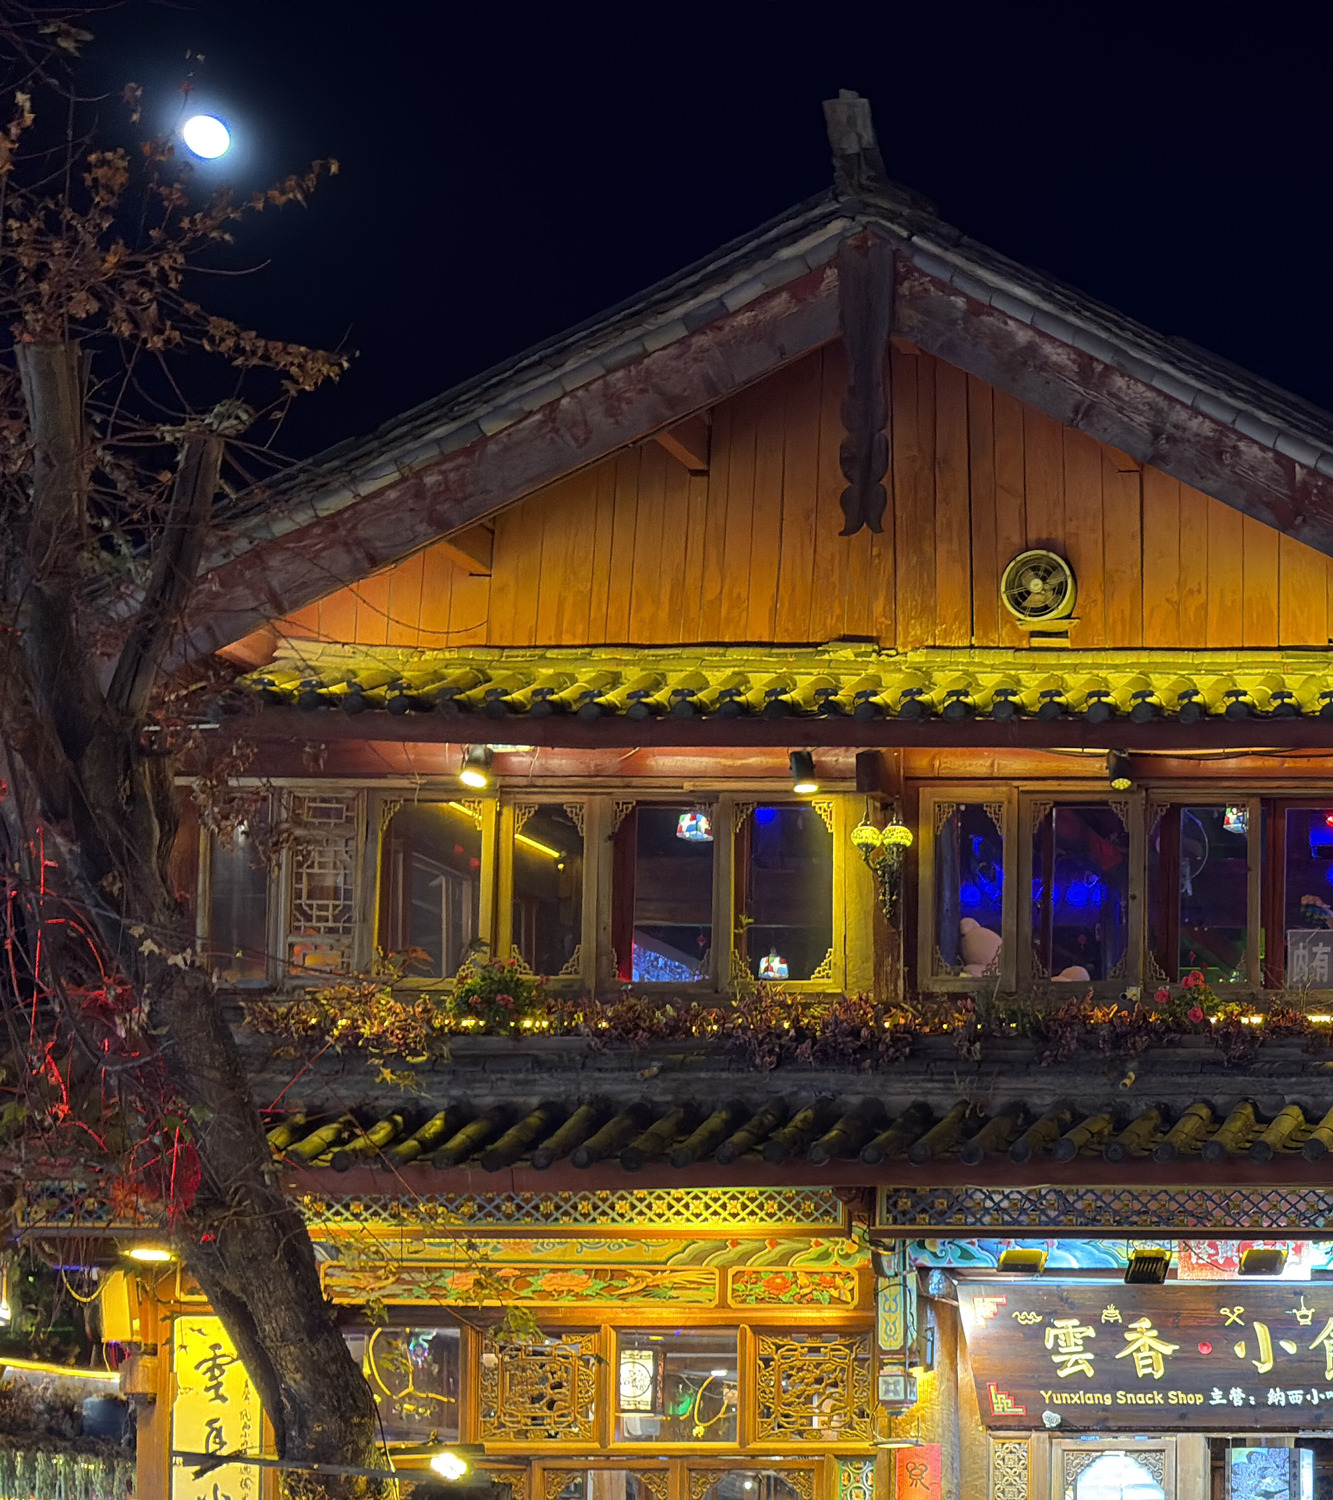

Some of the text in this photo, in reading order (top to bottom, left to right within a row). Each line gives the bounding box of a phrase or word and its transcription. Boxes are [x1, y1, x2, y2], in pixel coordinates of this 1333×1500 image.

[1040, 1389, 1112, 1406] Yunxiang
[1116, 1389, 1164, 1405] Snack
[1168, 1389, 1204, 1406] Shop
